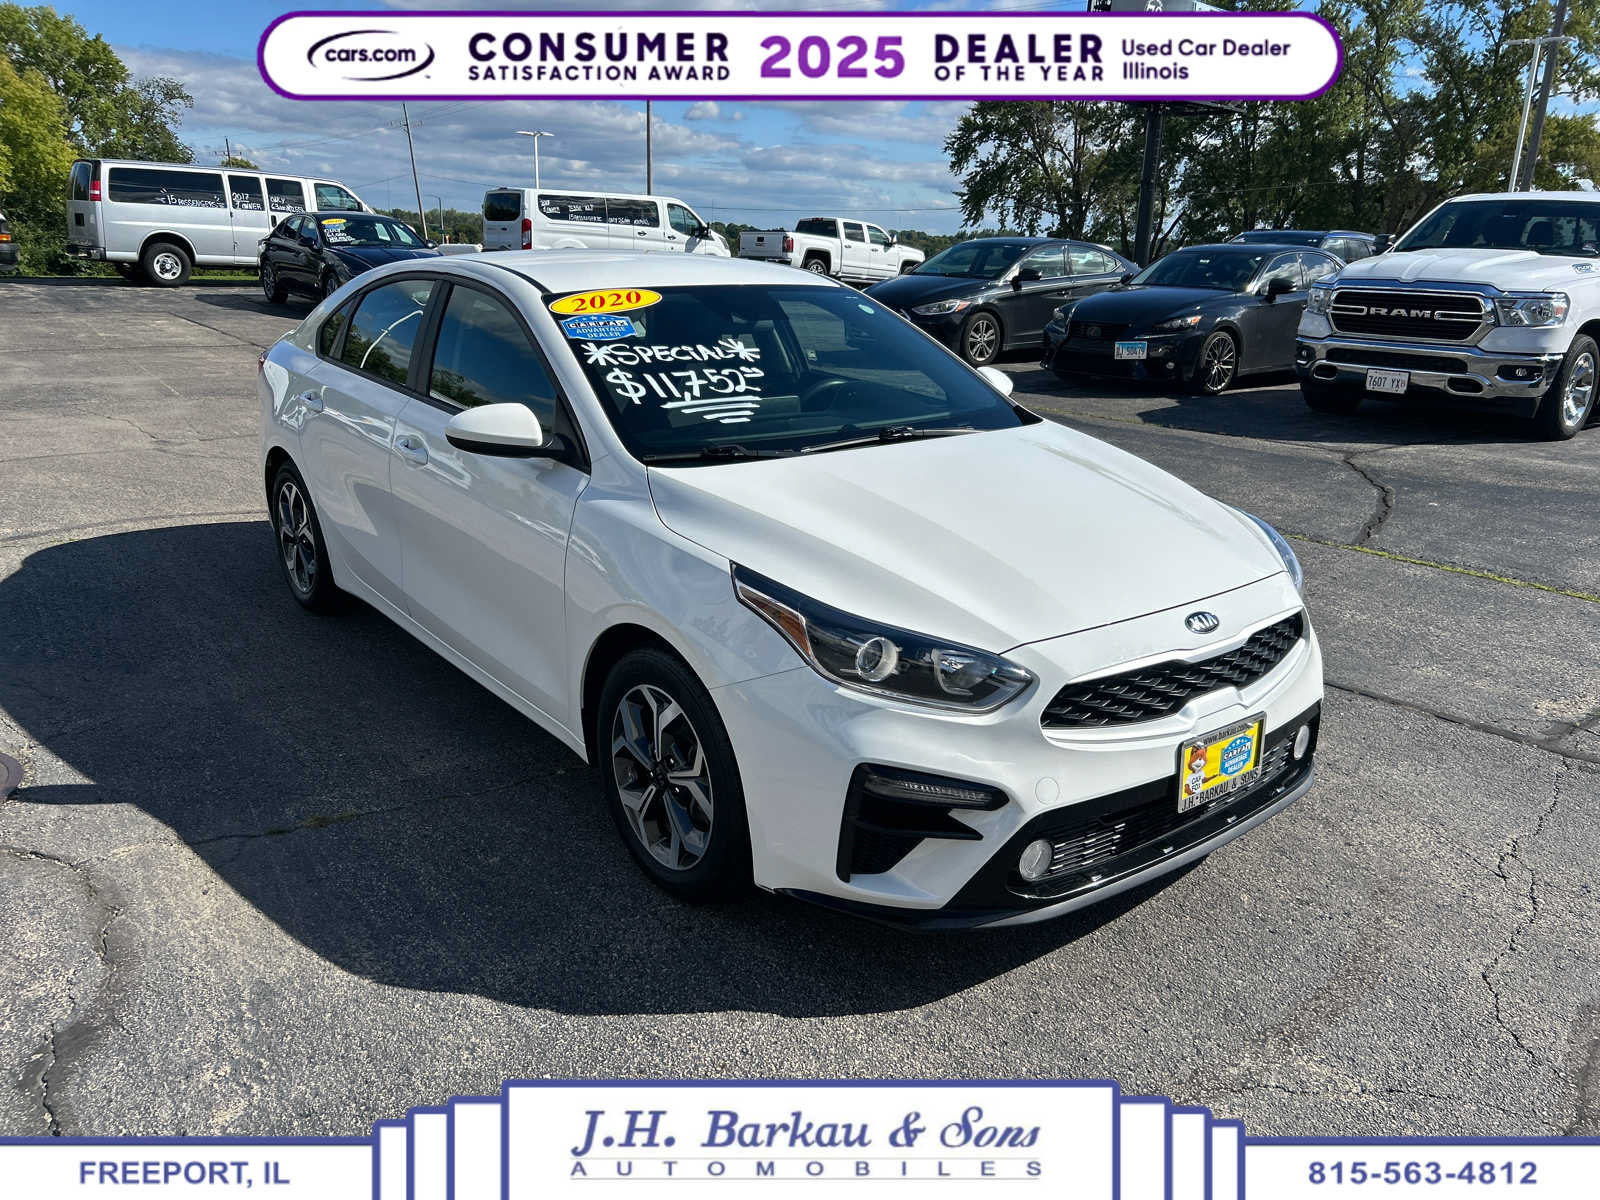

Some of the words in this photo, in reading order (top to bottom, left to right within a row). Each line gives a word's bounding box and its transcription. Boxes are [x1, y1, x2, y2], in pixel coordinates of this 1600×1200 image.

[572, 290, 642, 312] 2020
[1369, 307, 1431, 318] RAM
[576, 325, 626, 334] ADVANTAGE
[587, 331, 621, 339] DEALER
[1199, 781, 1229, 803] BARKAU
[1240, 767, 1259, 785] SONS
